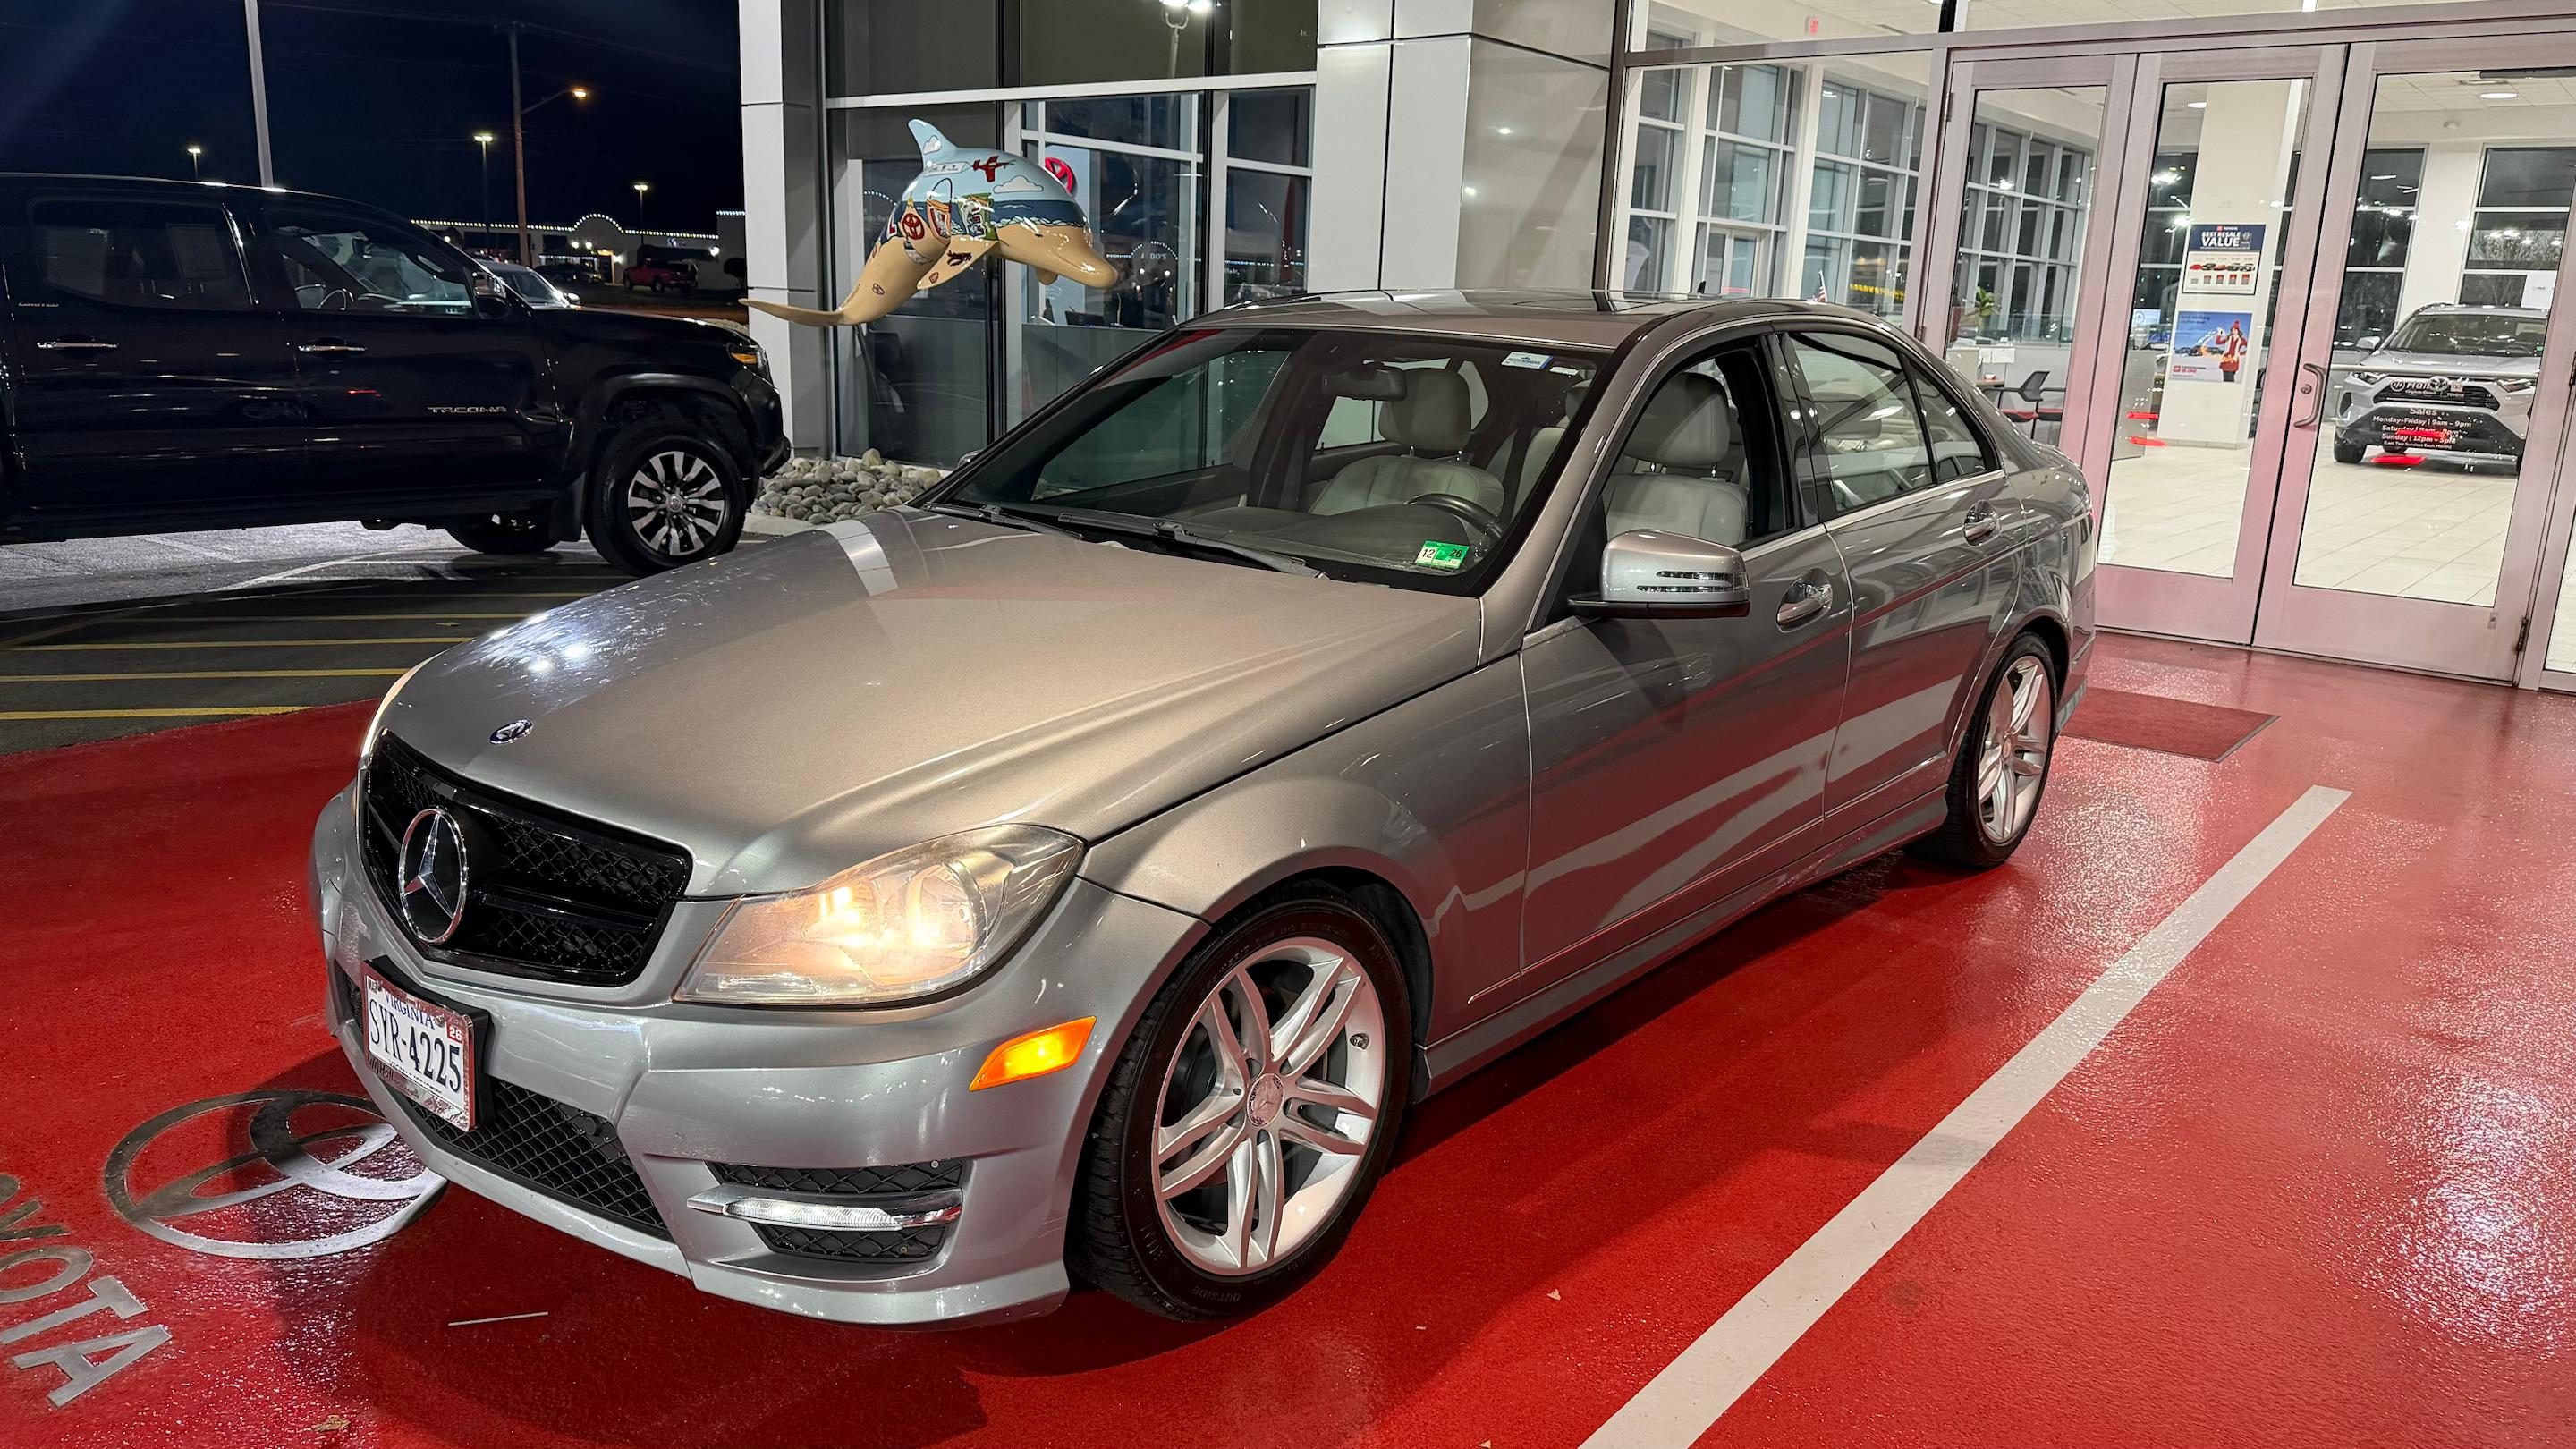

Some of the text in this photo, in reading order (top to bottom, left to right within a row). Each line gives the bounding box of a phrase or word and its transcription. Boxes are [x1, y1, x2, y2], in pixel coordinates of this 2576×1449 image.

[2202, 237, 2240, 247] VALUE
[2406, 381, 2430, 390] Hall
[2410, 408, 2437, 416] Sales
[2373, 416, 2427, 426] Monday-Friday
[2382, 433, 2409, 442] Sunday
[1422, 548, 1463, 558] 12 26
[385, 991, 435, 1030] VIRGINIA
[449, 1026, 462, 1040] 26
[369, 998, 462, 1093] SYR-4225
